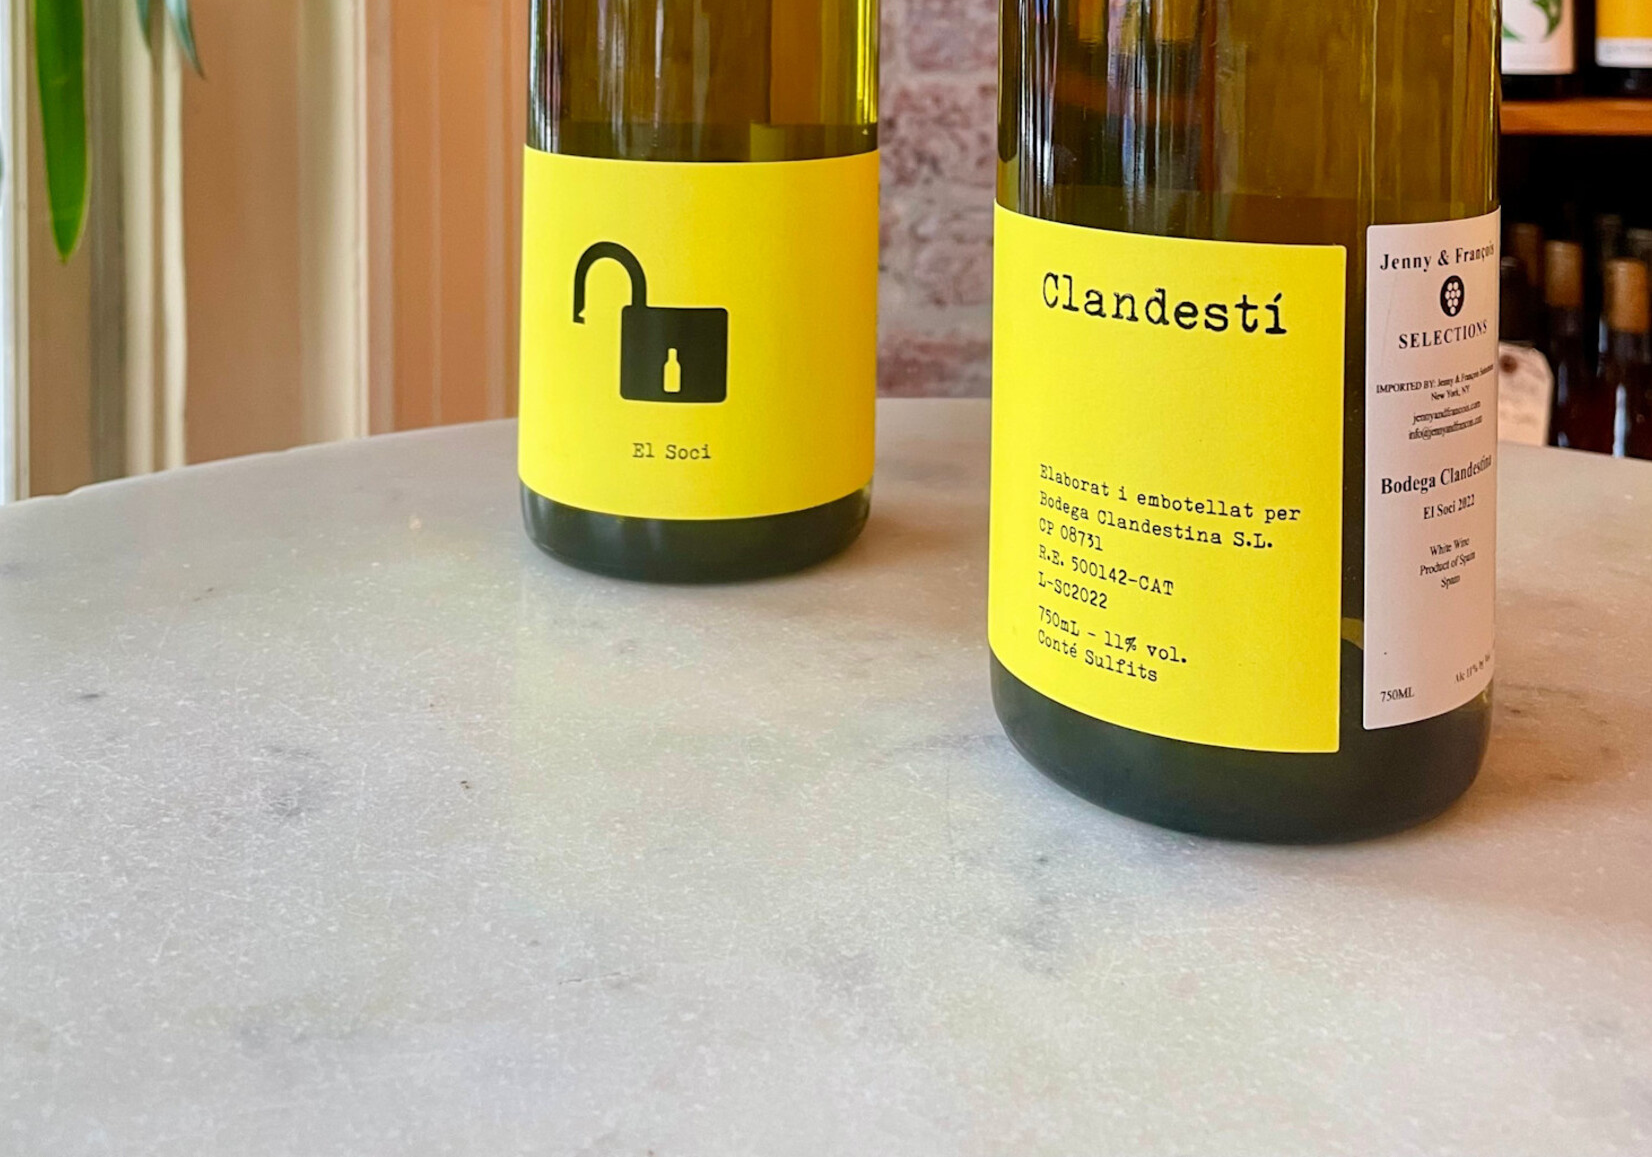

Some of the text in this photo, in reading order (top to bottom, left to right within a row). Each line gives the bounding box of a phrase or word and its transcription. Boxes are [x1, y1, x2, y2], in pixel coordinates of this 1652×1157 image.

[1380, 254, 1431, 272] Jenny
[1438, 250, 1449, 266] &
[1043, 272, 1287, 334] Clandestí
[1399, 319, 1487, 349] SELECTIONS
[1376, 381, 1422, 393] IMPORTED
[1431, 391, 1444, 400] New
[632, 442, 711, 460] El Soci
[1381, 455, 1492, 494] Bodega Clandestina
[1040, 463, 1300, 523] Elaborat i embotellat per
[1424, 494, 1475, 520] El Soci 2022
[1039, 517, 1103, 551] CP 08731
[1040, 491, 1273, 549] Bodega Clandestina S.L.
[1430, 537, 1469, 556] White Wine
[1039, 544, 1174, 596] R.E. 500142-CAT
[1420, 561, 1449, 576] Product
[1451, 555, 1459, 567] of
[1038, 571, 1108, 609] L-SC2022
[1038, 605, 1080, 637] 750mL
[1104, 630, 1137, 652] 11%
[1147, 644, 1187, 663] vol.
[1038, 629, 1157, 682] Conté Sulfits
[1380, 687, 1414, 702] 750ML
